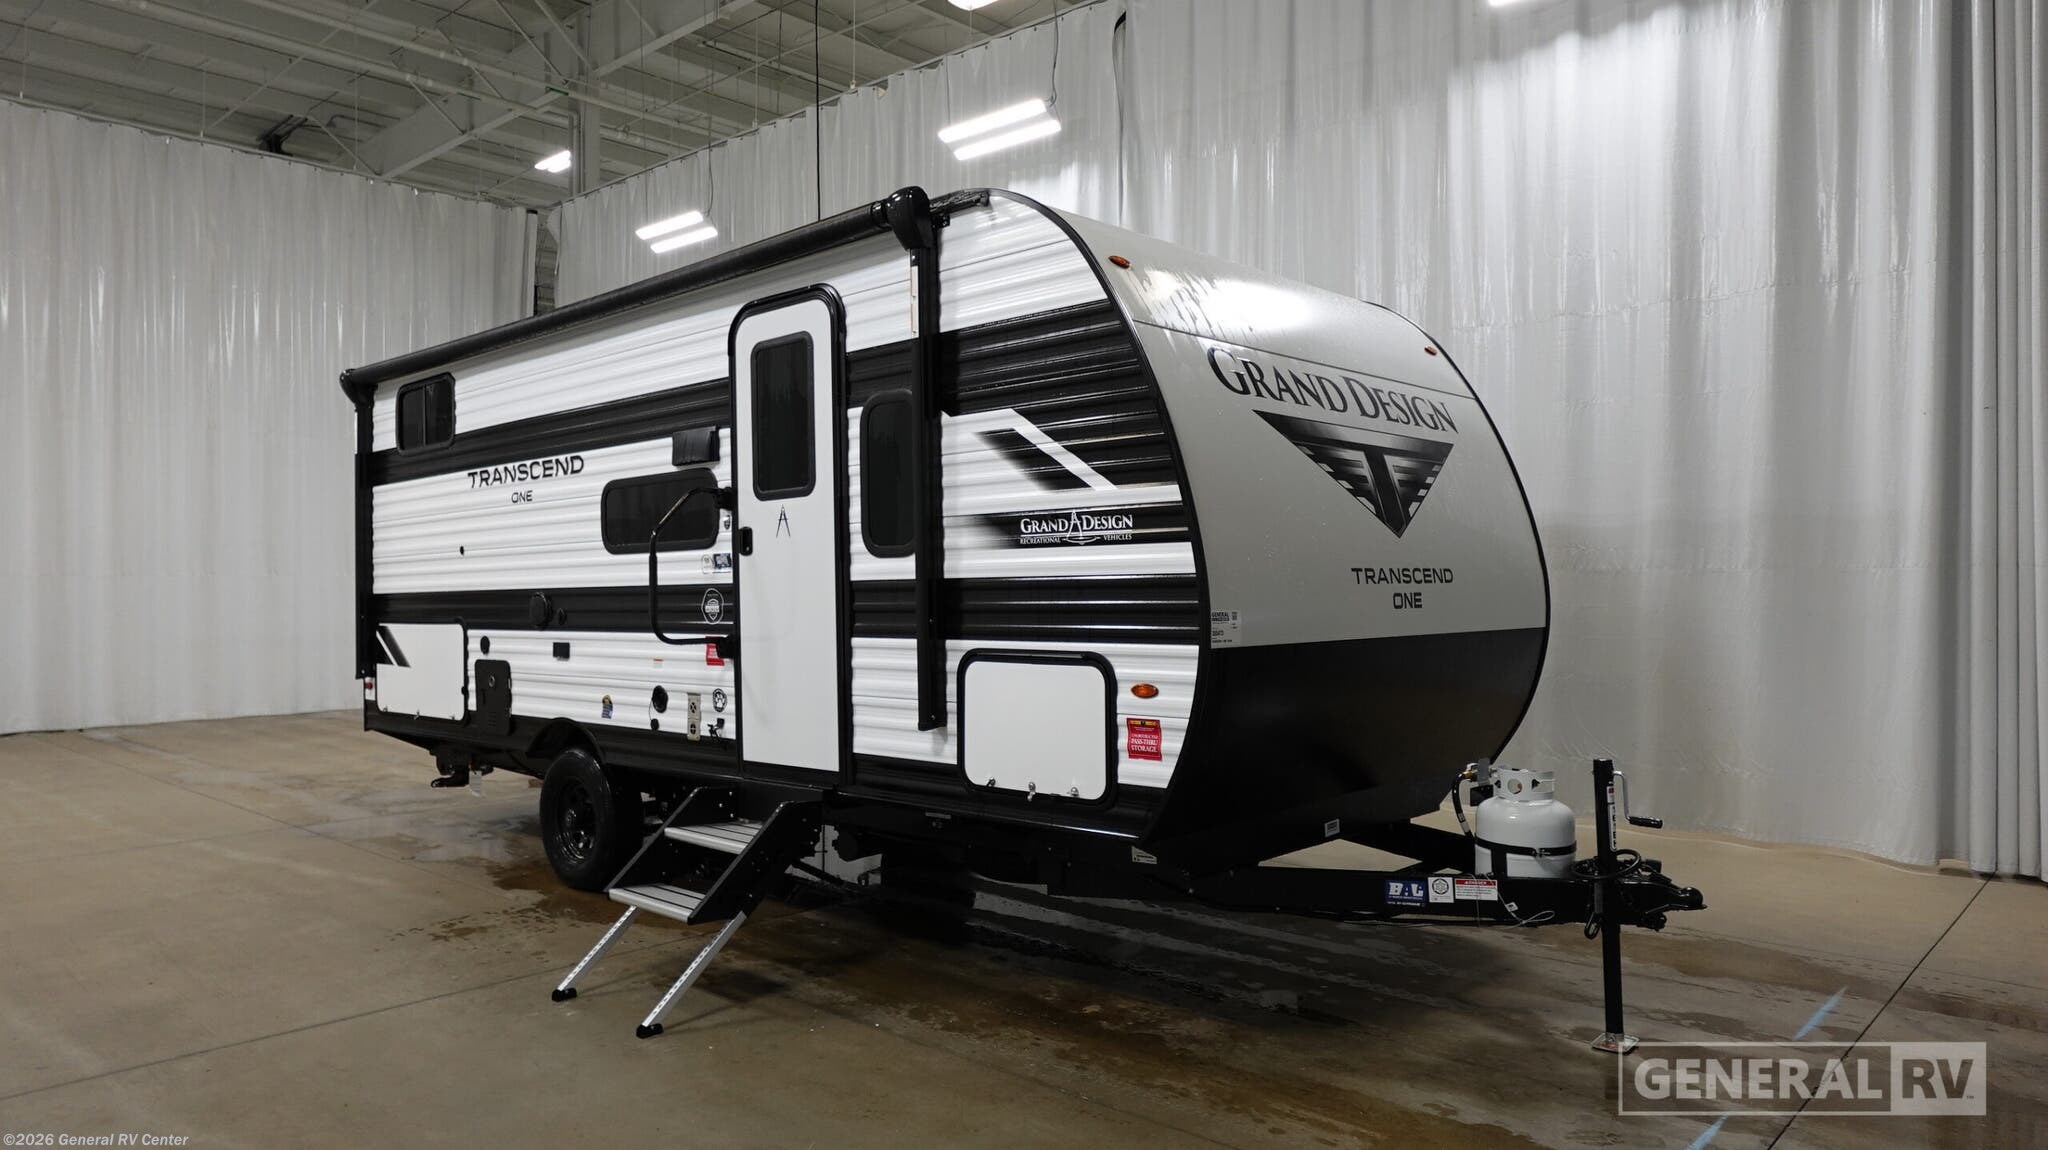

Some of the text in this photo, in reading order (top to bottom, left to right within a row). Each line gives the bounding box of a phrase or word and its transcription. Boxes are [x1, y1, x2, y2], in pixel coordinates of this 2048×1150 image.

[1207, 347, 1459, 434] GRAND DESIGN
[467, 455, 585, 488] TRANSCEND
[511, 489, 534, 504] ONE
[1020, 514, 1133, 534] GRAND DESIGN
[1020, 533, 1133, 545] RECREATIONAL VEHICLES
[1350, 567, 1454, 584] TRANSCEND
[1393, 592, 1422, 609] ONE
